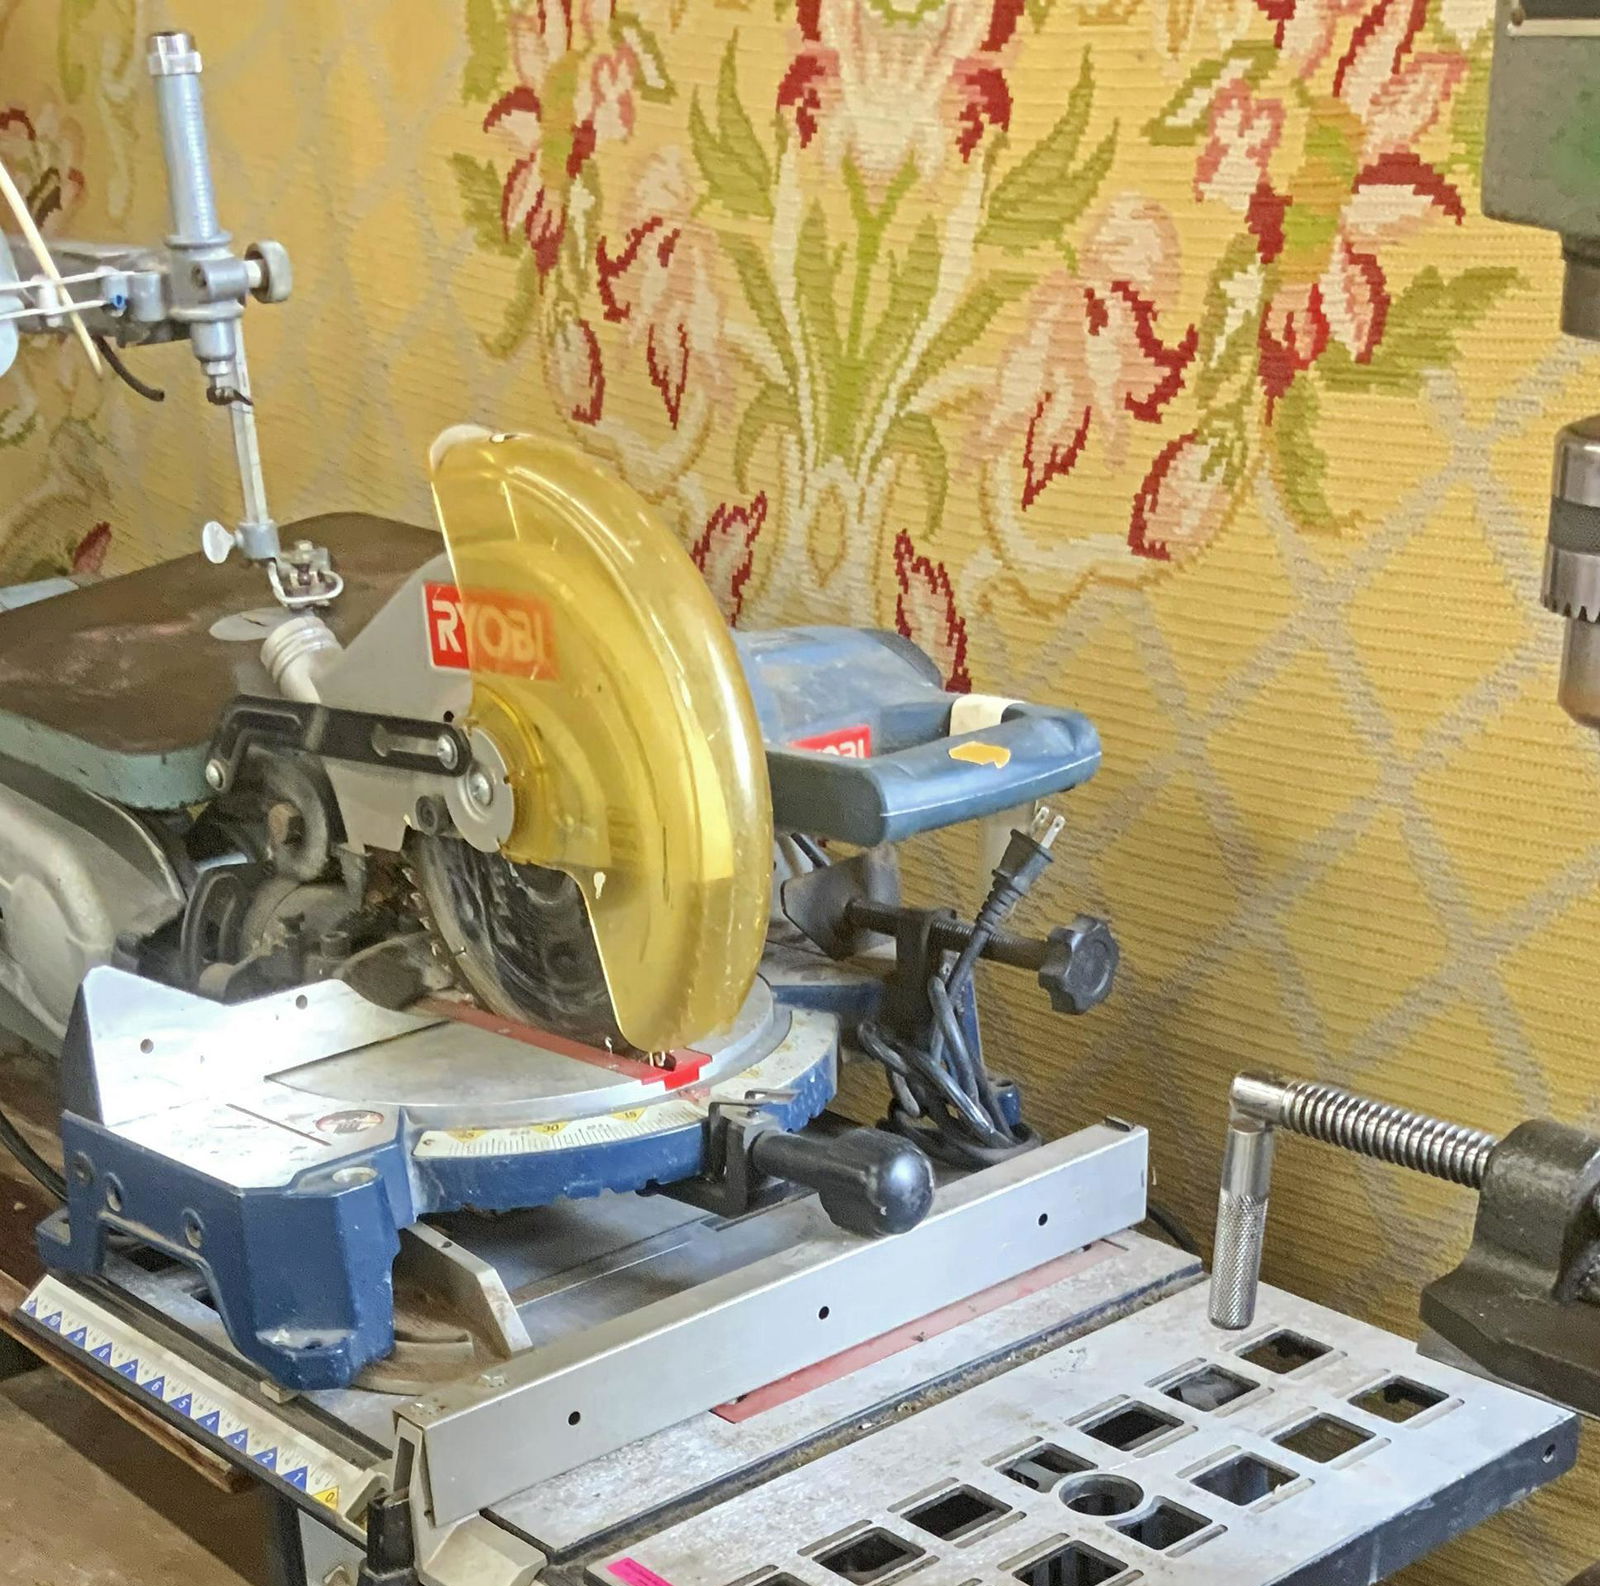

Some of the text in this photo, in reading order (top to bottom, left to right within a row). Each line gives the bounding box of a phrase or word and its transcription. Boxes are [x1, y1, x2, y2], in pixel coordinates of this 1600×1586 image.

[431, 599, 544, 662] RYOBI
[124, 1363, 136, 1374] 7
[151, 1380, 163, 1392] 6
[178, 1397, 190, 1409] 5
[206, 1416, 217, 1427] 4
[233, 1434, 245, 1445] 3
[261, 1452, 274, 1464] 2
[292, 1472, 304, 1483] 1
[324, 1491, 335, 1503] 0
